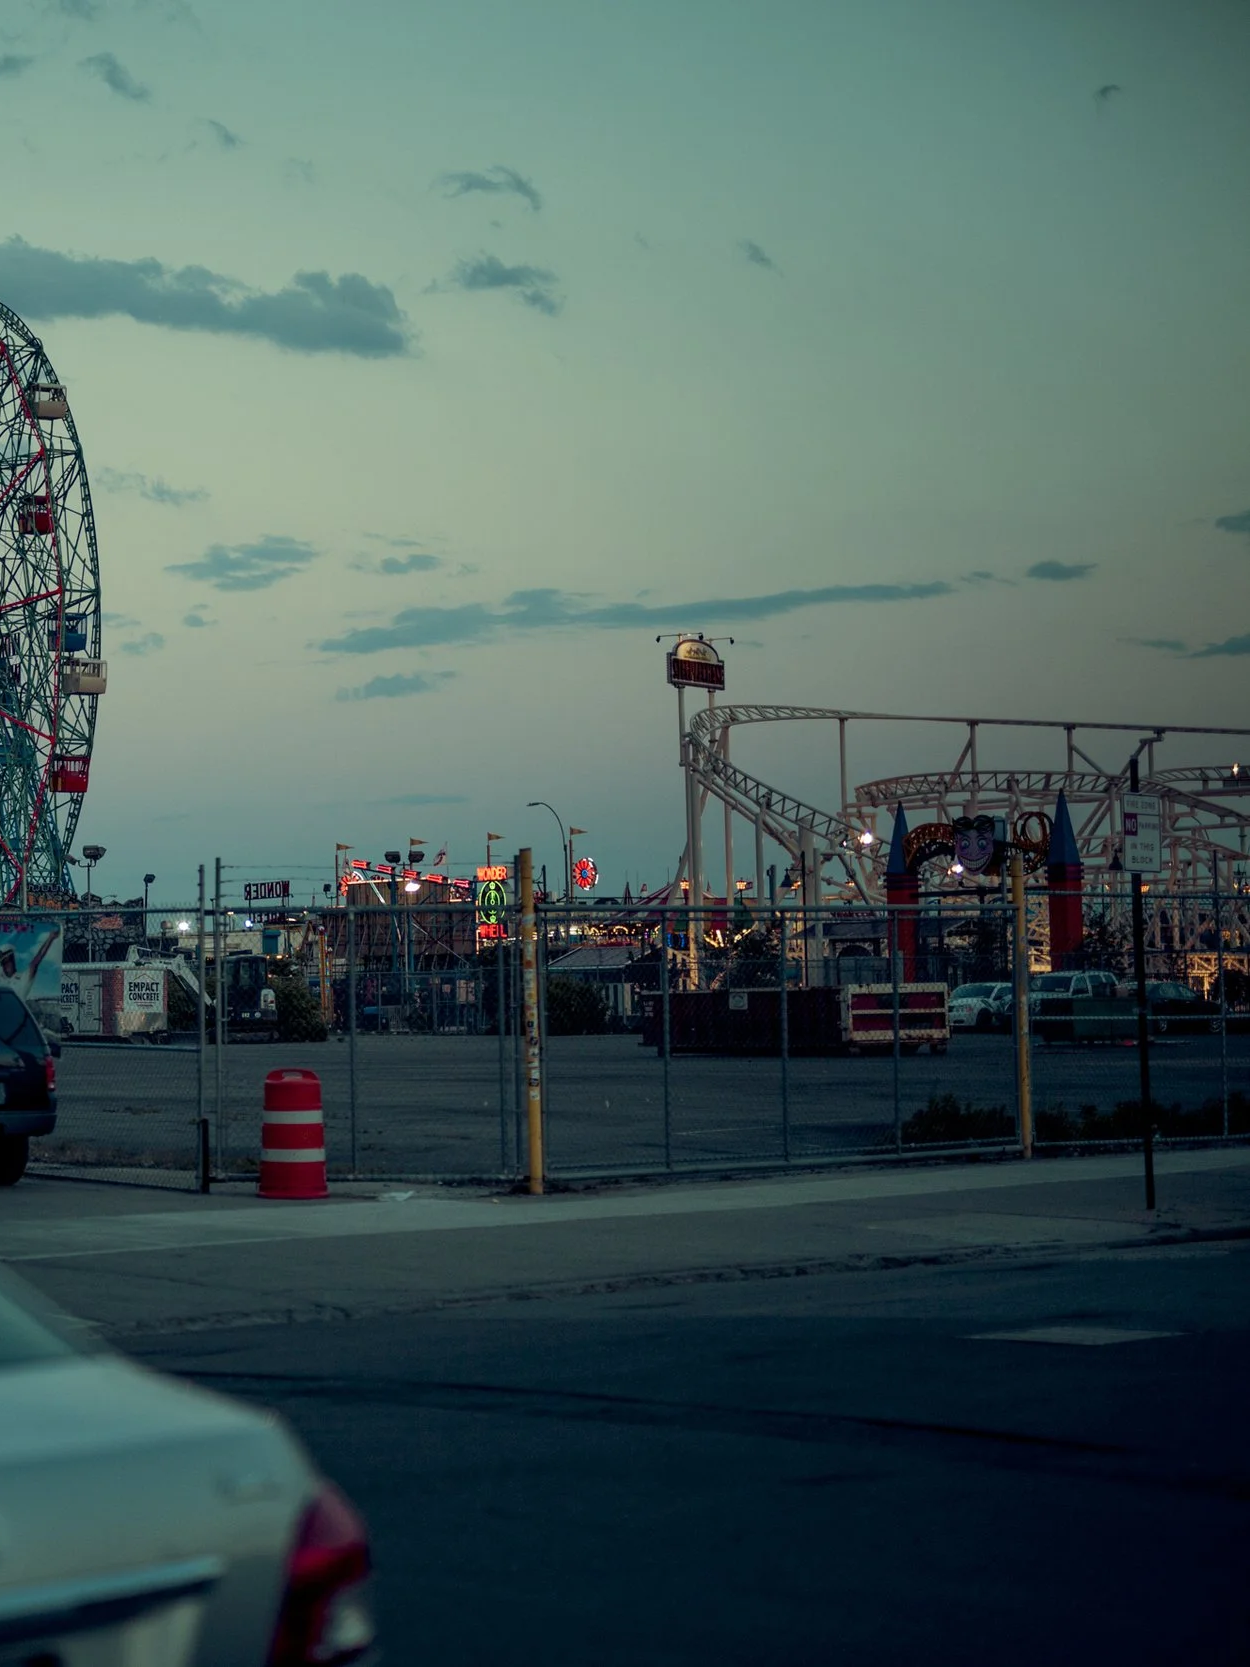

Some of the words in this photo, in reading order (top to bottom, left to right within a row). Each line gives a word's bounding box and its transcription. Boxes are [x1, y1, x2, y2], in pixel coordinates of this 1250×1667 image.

[1125, 818, 1137, 832] NO
[1132, 855, 1153, 864] BLOCK
[477, 866, 507, 881] WONDER
[61, 983, 78, 994] PACT
[128, 982, 159, 992] EMPACT
[61, 994, 78, 1003] CRETE
[128, 992, 159, 1001] CONCRETE
